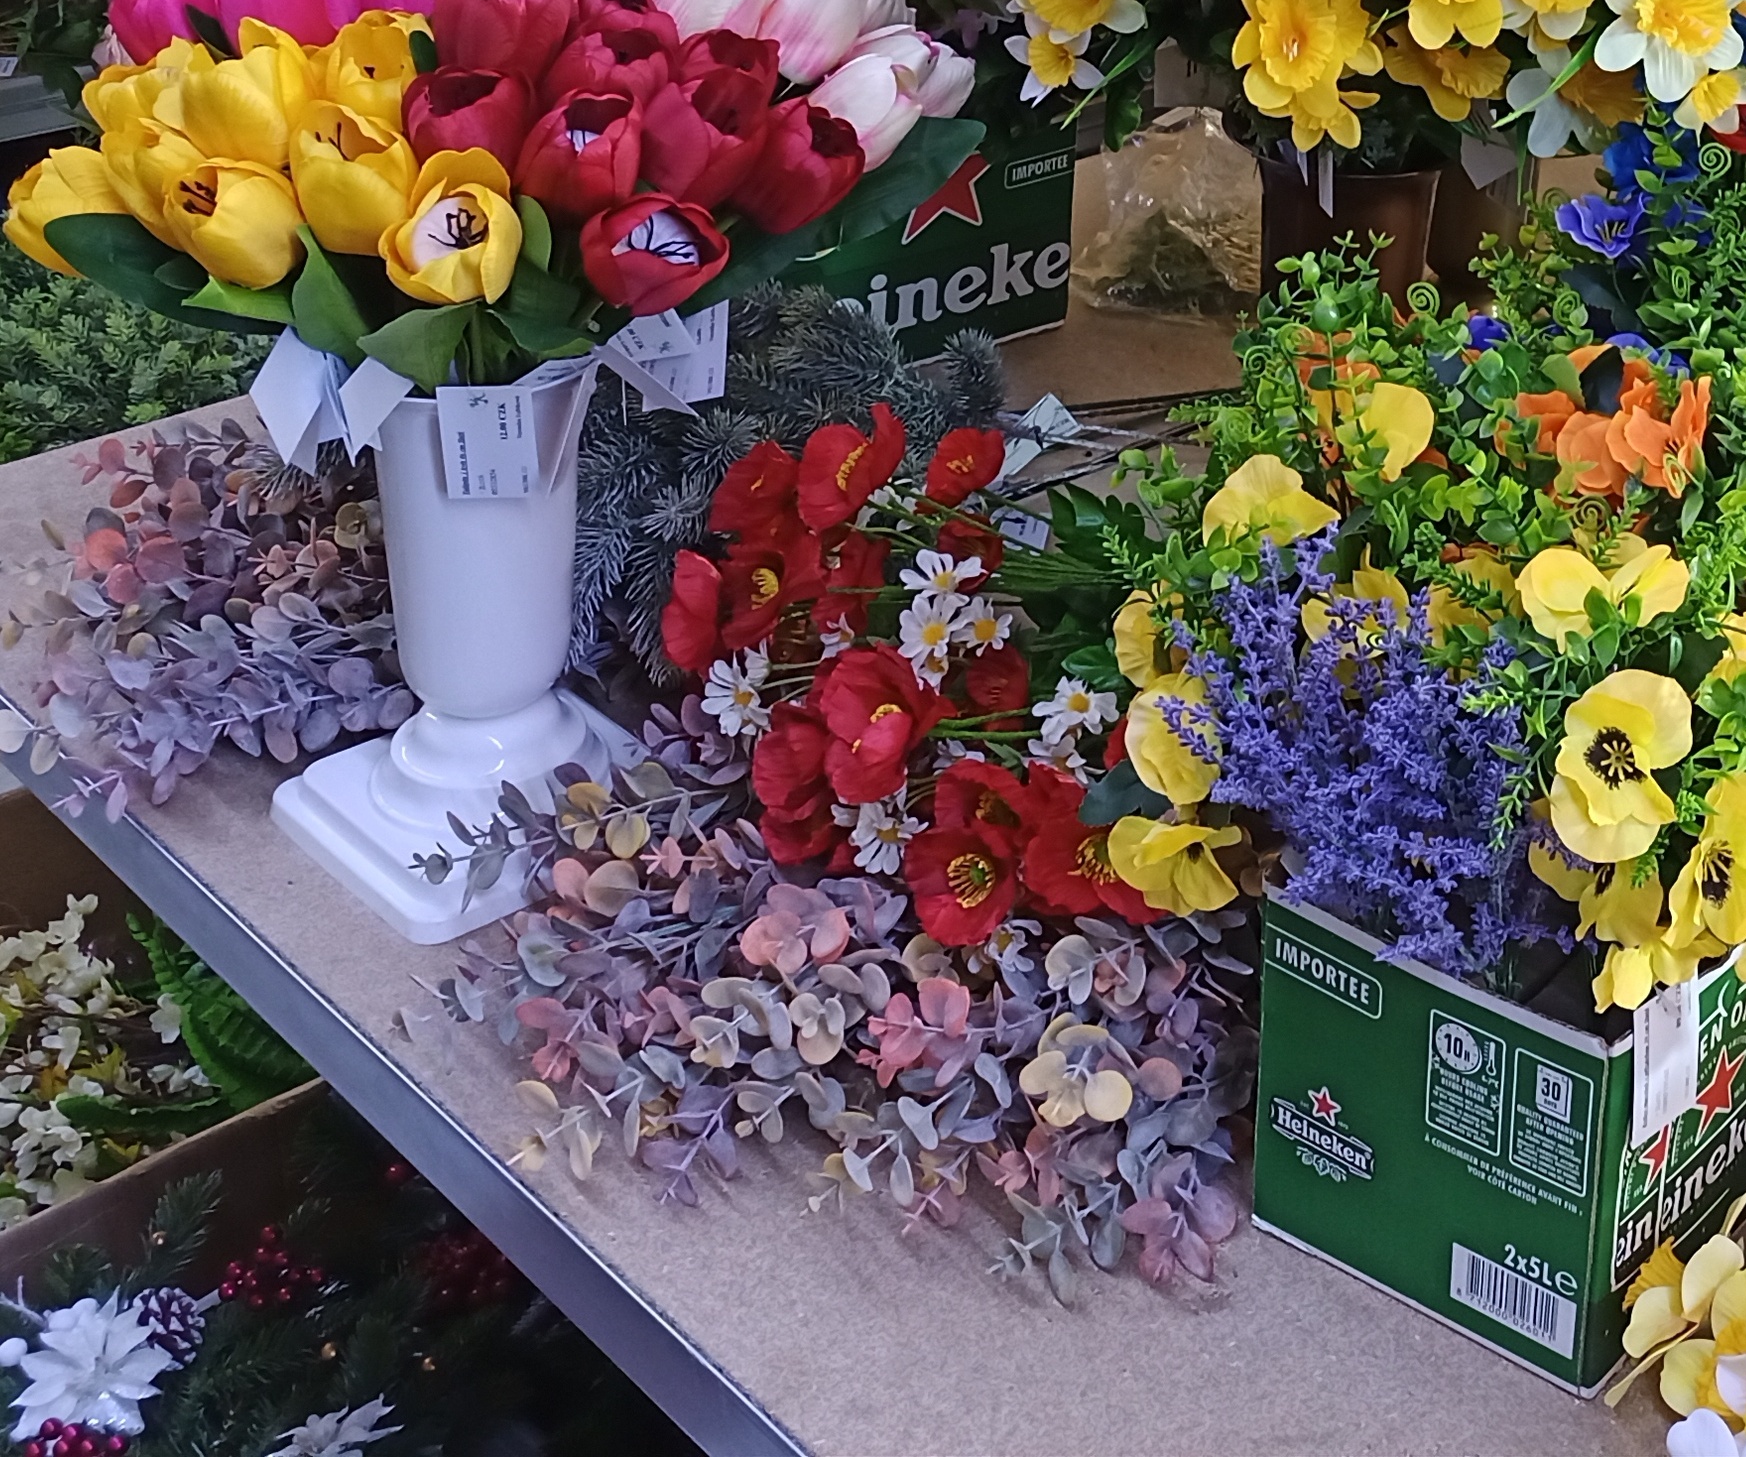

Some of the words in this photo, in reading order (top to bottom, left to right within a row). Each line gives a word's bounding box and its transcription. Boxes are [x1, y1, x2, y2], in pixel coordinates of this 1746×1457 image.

[1012, 154, 1069, 182] IMPORTEE
[1275, 937, 1370, 1006] IMPORTEE
[1541, 1077, 1562, 1101] 30
[1277, 1106, 1368, 1171] Heineken
[1431, 1137, 1478, 1166] CONSOMMER
[1480, 1160, 1490, 1172] DE
[1538, 1188, 1562, 1206] AVANT
[1467, 1164, 1486, 1180] VOIR
[1508, 1184, 1537, 1205] CARTON
